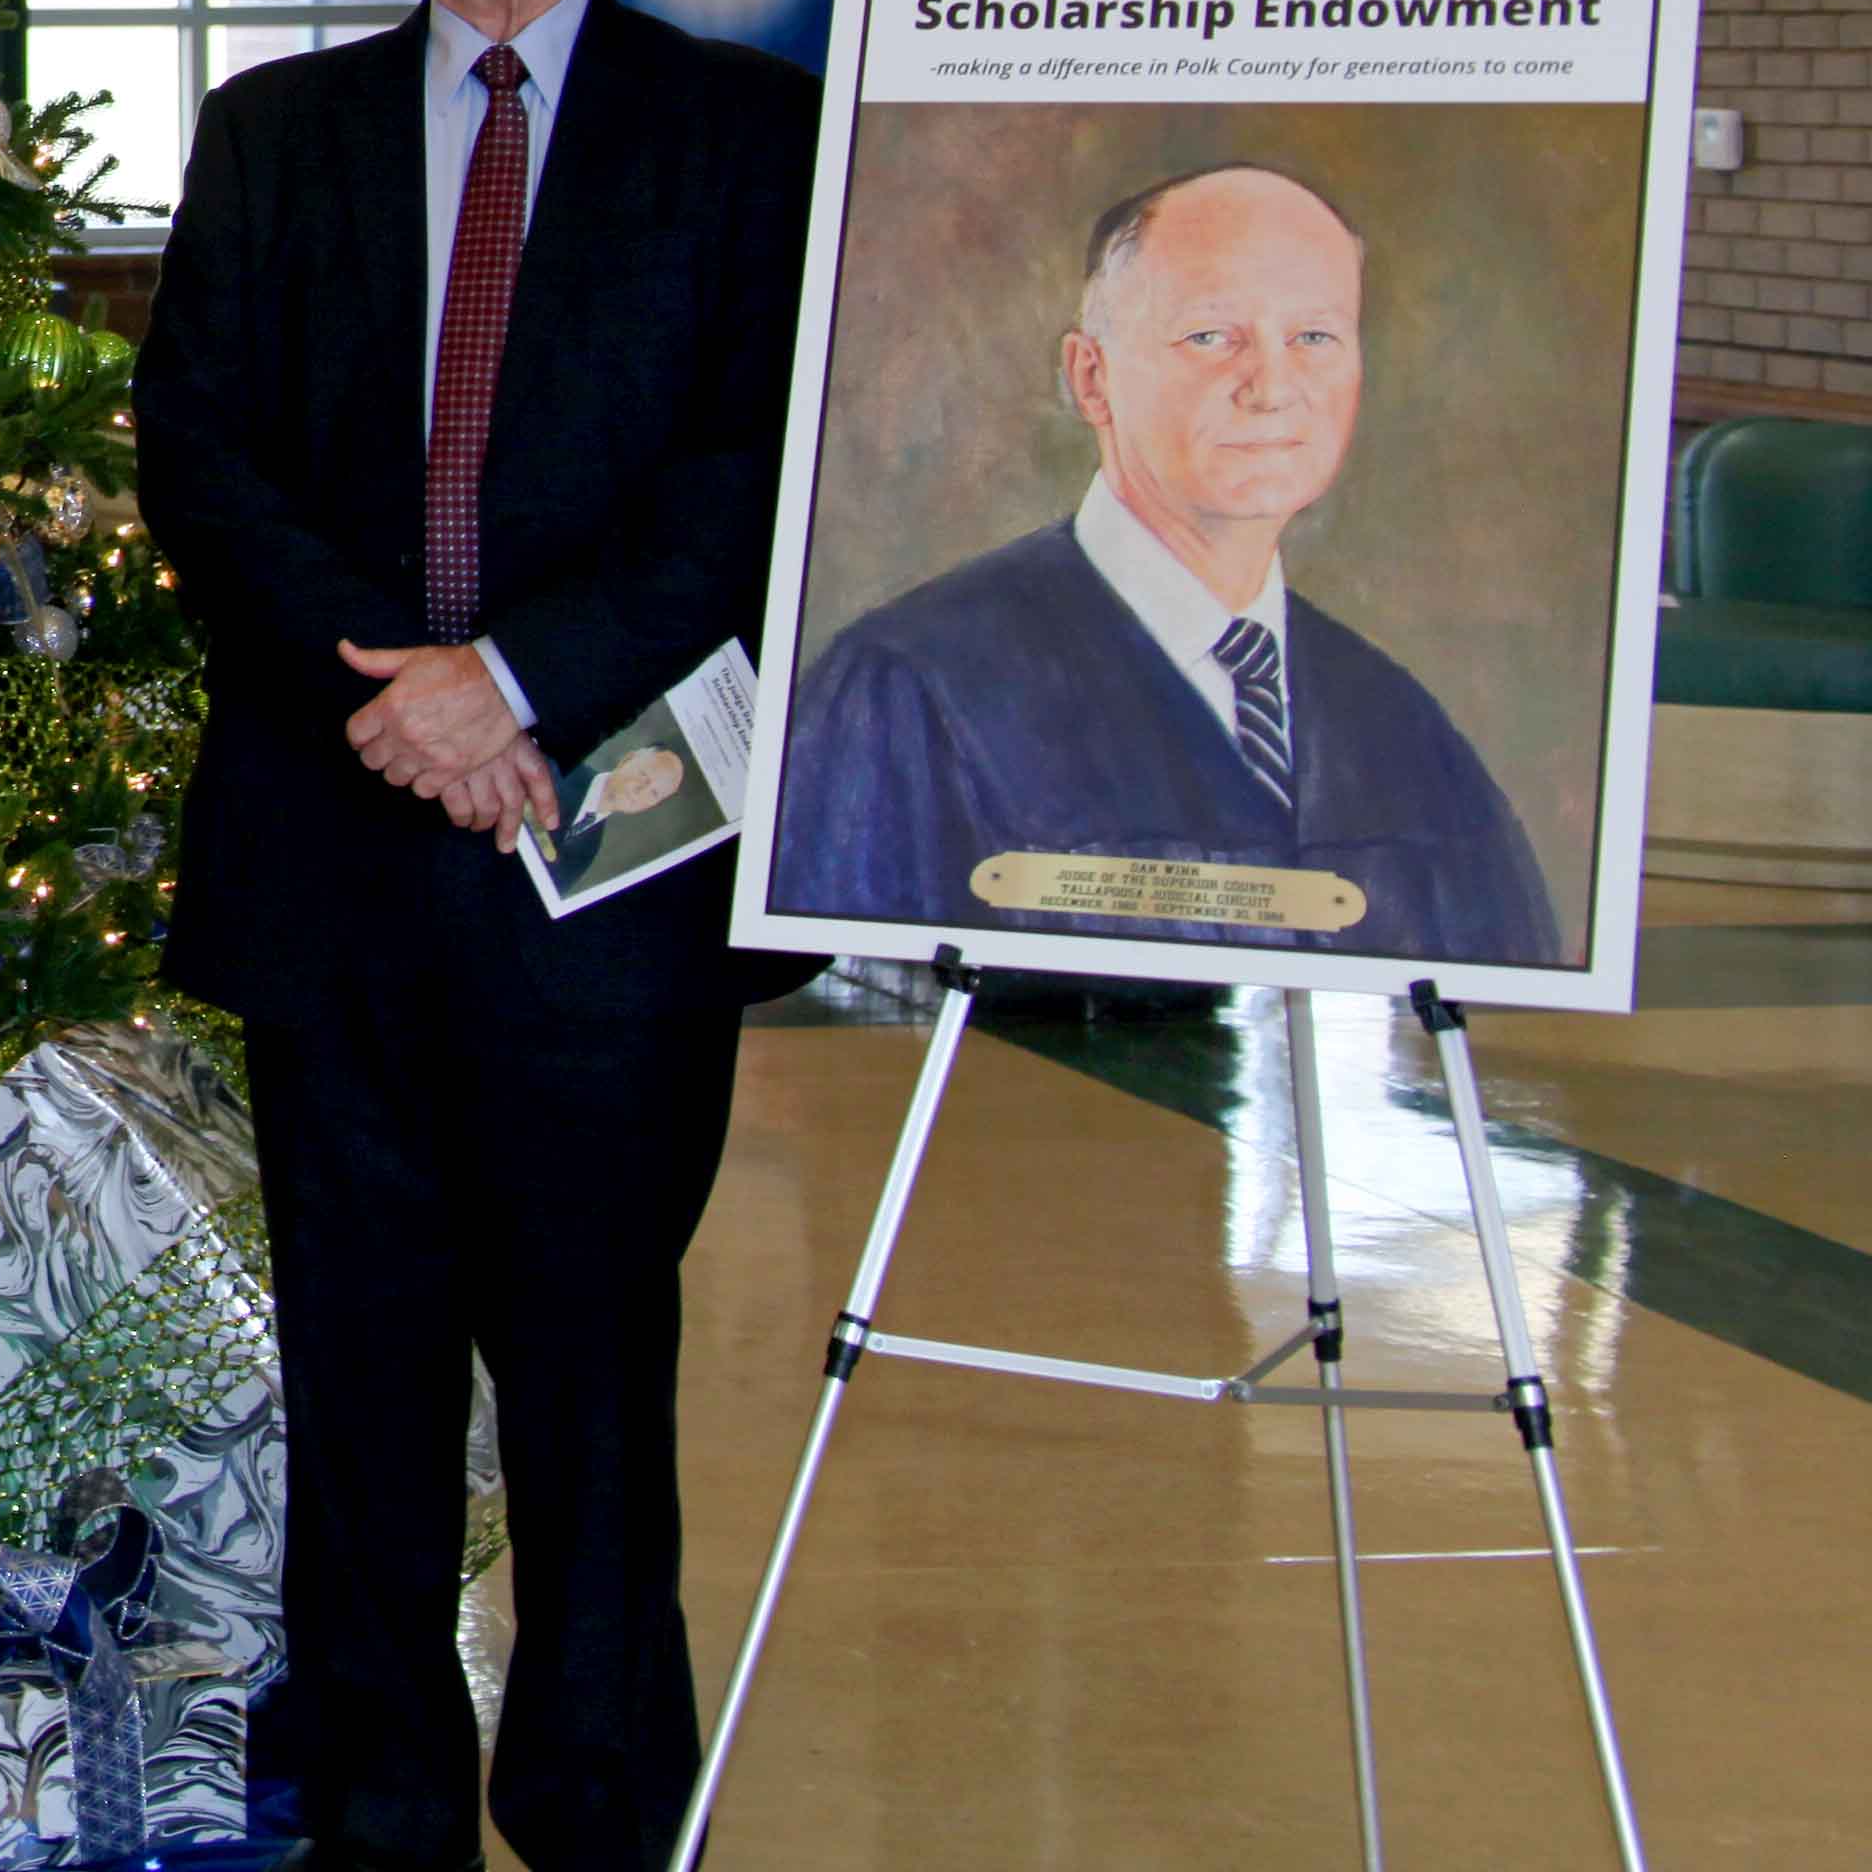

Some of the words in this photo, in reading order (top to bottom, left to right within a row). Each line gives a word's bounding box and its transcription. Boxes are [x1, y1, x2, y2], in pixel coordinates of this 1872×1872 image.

[1019, 64, 1031, 76] a
[1038, 57, 1142, 80] difference
[1148, 57, 1168, 76] in
[1175, 57, 1219, 76] Polk
[1227, 57, 1304, 80] County
[1305, 56, 1341, 80] for
[1345, 57, 1476, 79] generations
[1484, 57, 1507, 76] to
[1513, 59, 1575, 76] come
[1060, 883, 1145, 898] TALLAPOOSA
[1101, 871, 1116, 884] OF
[1122, 873, 1145, 886] THE
[1152, 875, 1219, 891] SUPERIOR
